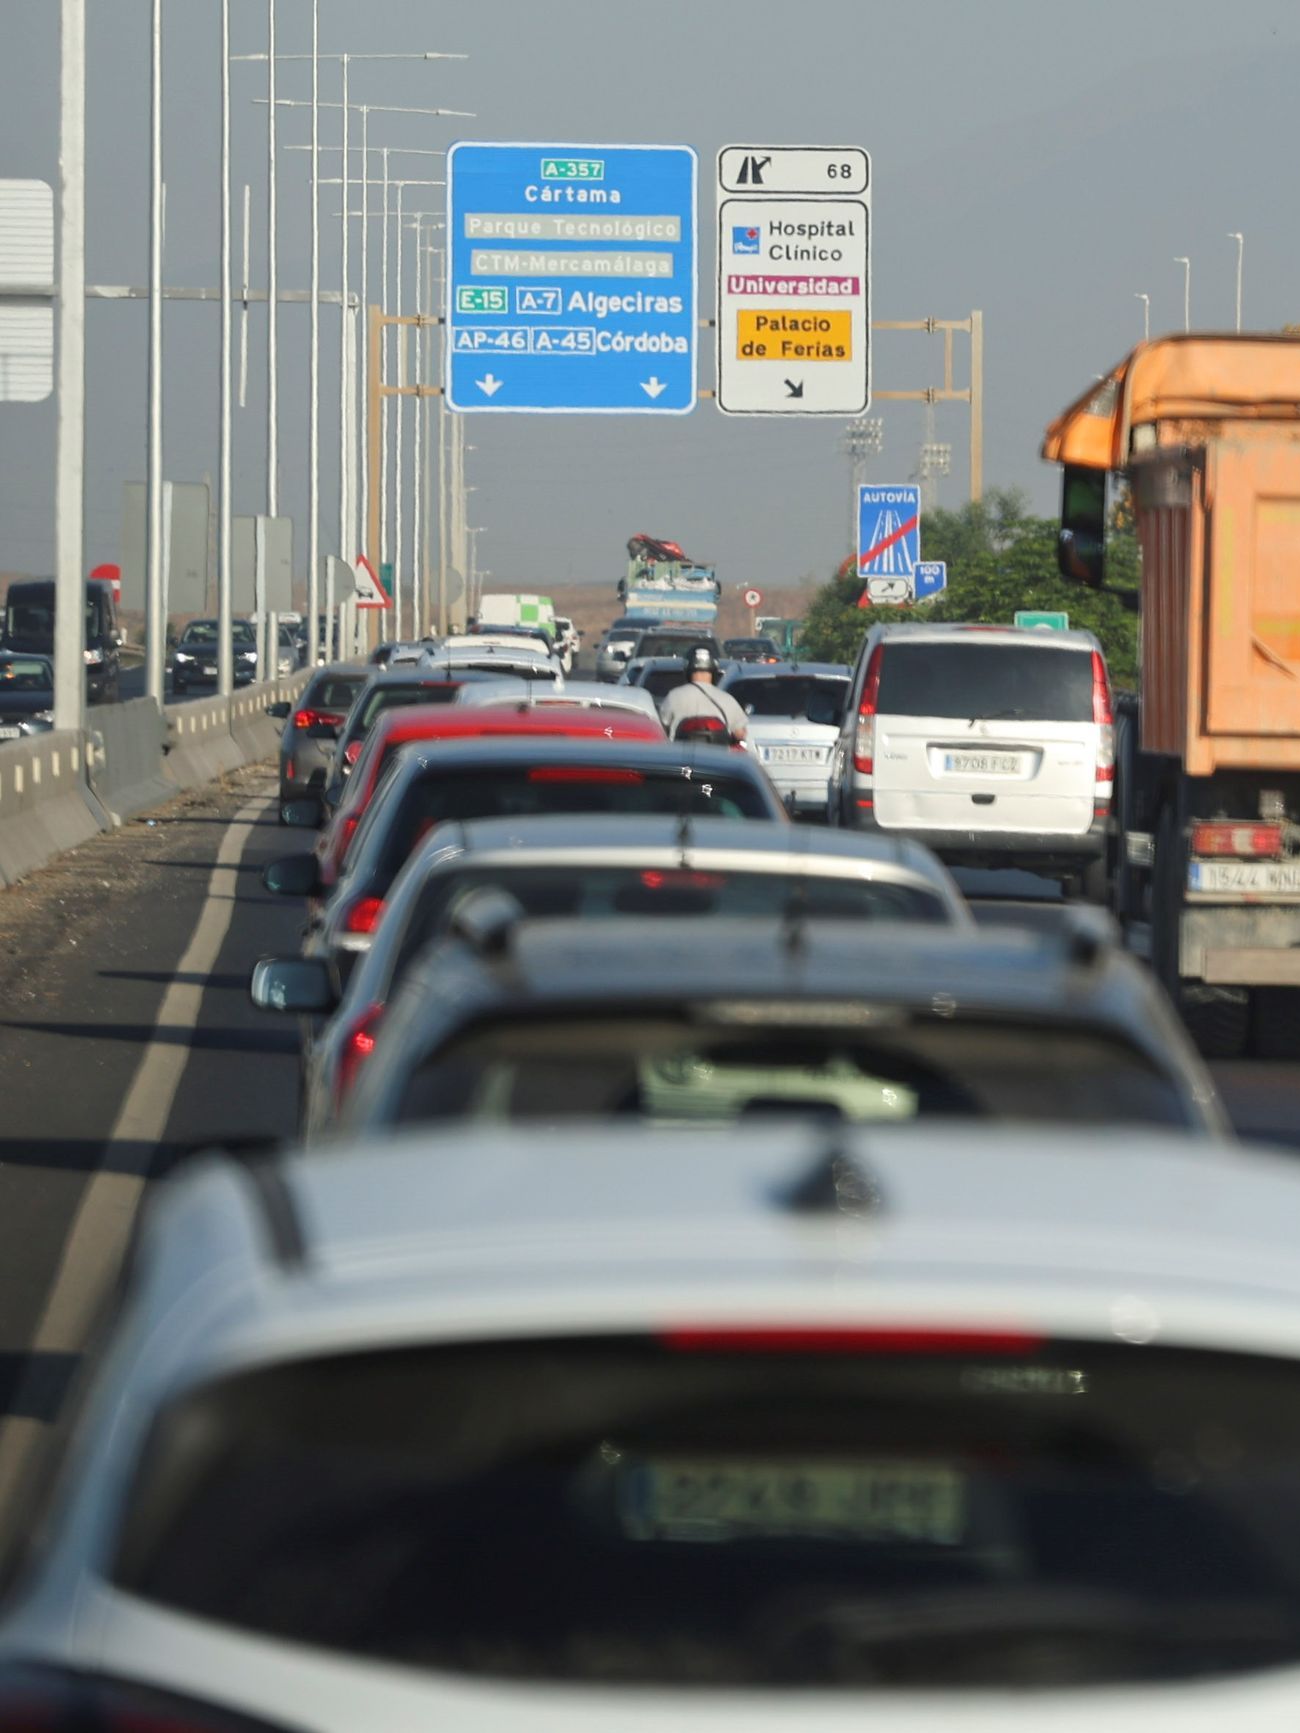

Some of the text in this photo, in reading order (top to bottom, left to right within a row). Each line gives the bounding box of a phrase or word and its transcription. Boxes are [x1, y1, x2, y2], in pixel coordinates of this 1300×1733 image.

[546, 162, 602, 177] A-357
[827, 163, 852, 179] 68
[525, 185, 621, 203] Cártama
[469, 218, 677, 240] Parque Tecnológico
[769, 220, 855, 240] Hospital
[769, 244, 843, 261] Clínico
[475, 254, 670, 277] CTM-Mercamálaga
[730, 277, 853, 294] Universidad
[460, 290, 683, 318] E-15 A-7 Algeciras
[756, 315, 831, 332] Palacio
[457, 330, 689, 353] AP-46 A-45 Córdoba
[741, 340, 845, 358] de Ferias
[920, 566, 940, 575] 100
